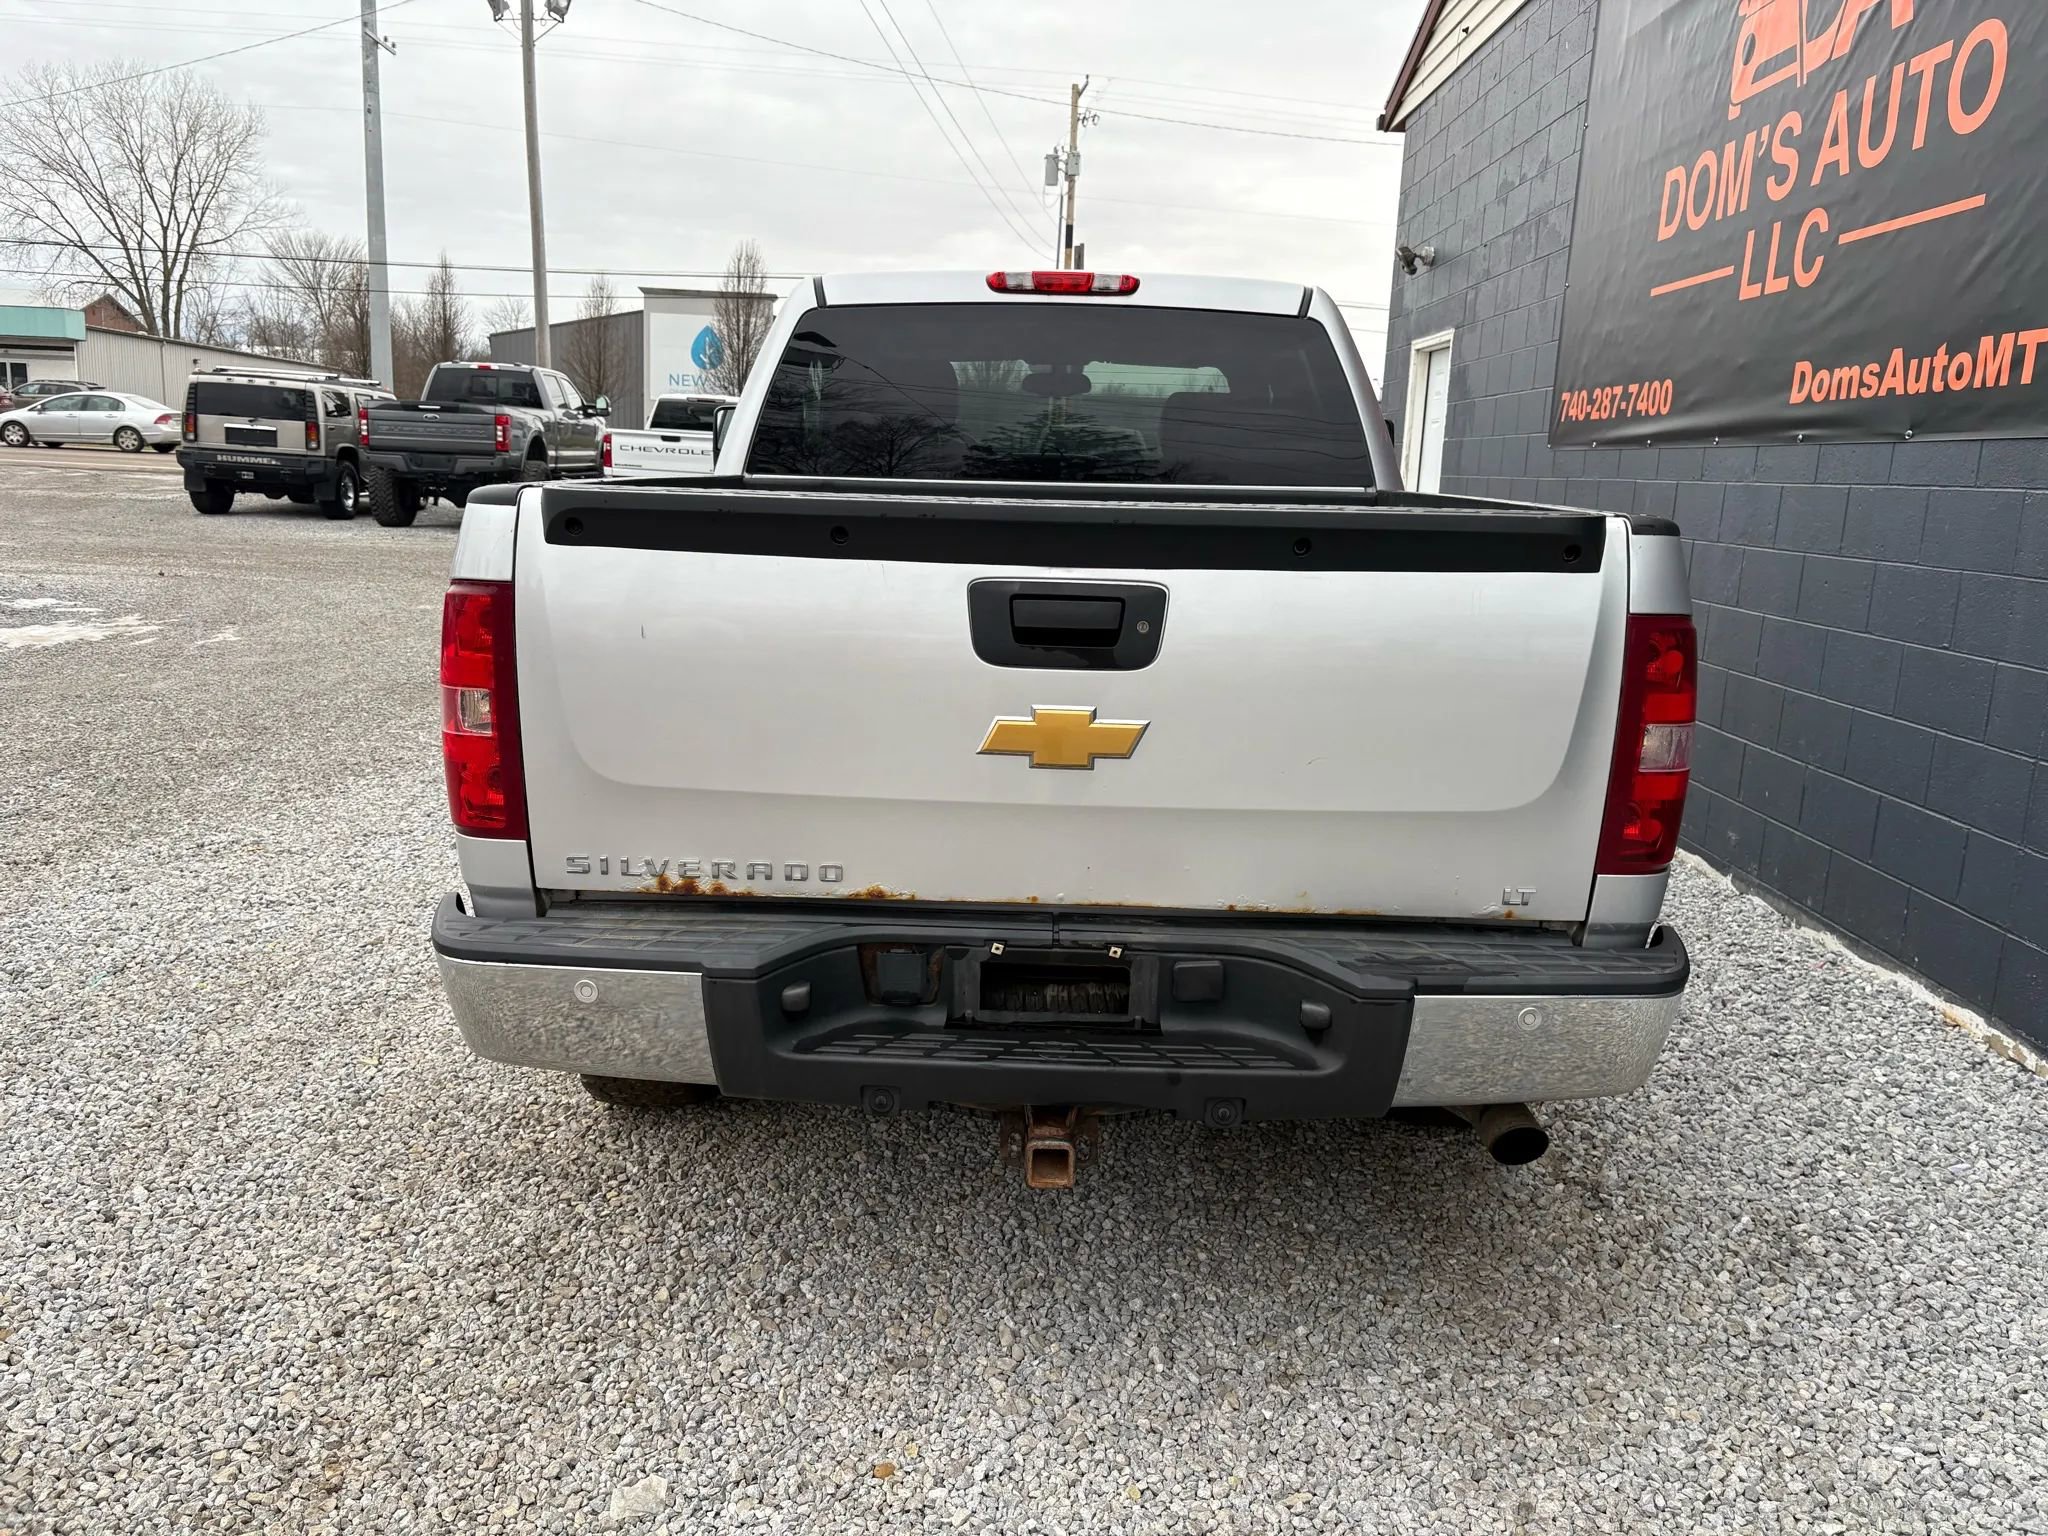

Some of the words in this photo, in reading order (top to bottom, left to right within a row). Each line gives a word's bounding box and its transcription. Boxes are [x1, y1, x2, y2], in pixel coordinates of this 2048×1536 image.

[1657, 110, 1803, 242] DOM'S
[1810, 18, 2009, 187] AUTO
[1738, 207, 1829, 301] LLC
[1561, 378, 1673, 422] 740-287-7400
[566, 855, 844, 882] SILVERADO
[1502, 888, 1537, 906] LT
